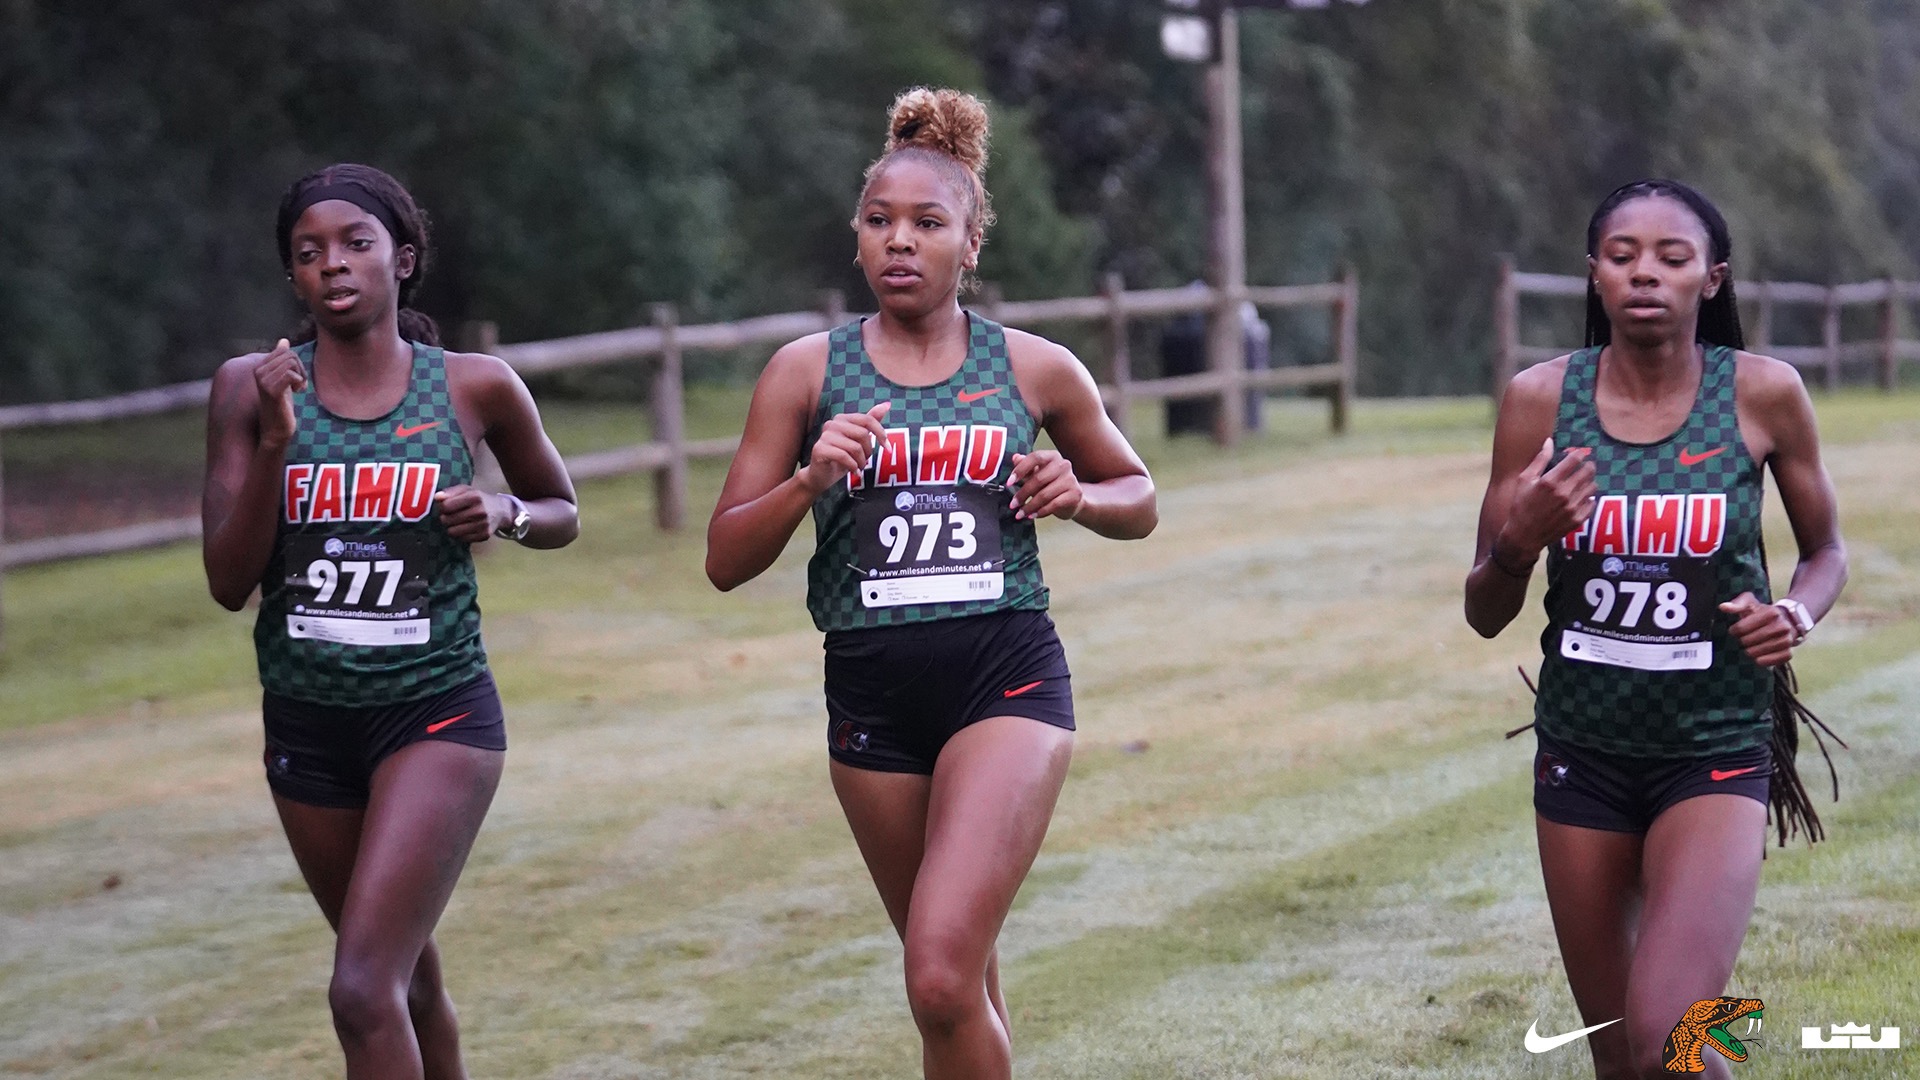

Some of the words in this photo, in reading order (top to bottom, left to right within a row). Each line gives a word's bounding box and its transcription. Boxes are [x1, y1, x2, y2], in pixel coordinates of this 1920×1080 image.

[286, 462, 441, 524] FAMU
[878, 511, 977, 564] 973
[307, 559, 404, 607] 977
[879, 563, 982, 578] www.milesandminutes.net
[305, 607, 409, 619] www.milesandminutes.net
[1583, 578, 1688, 630] 978
[1582, 625, 1690, 643] www.milesandminutes.net
